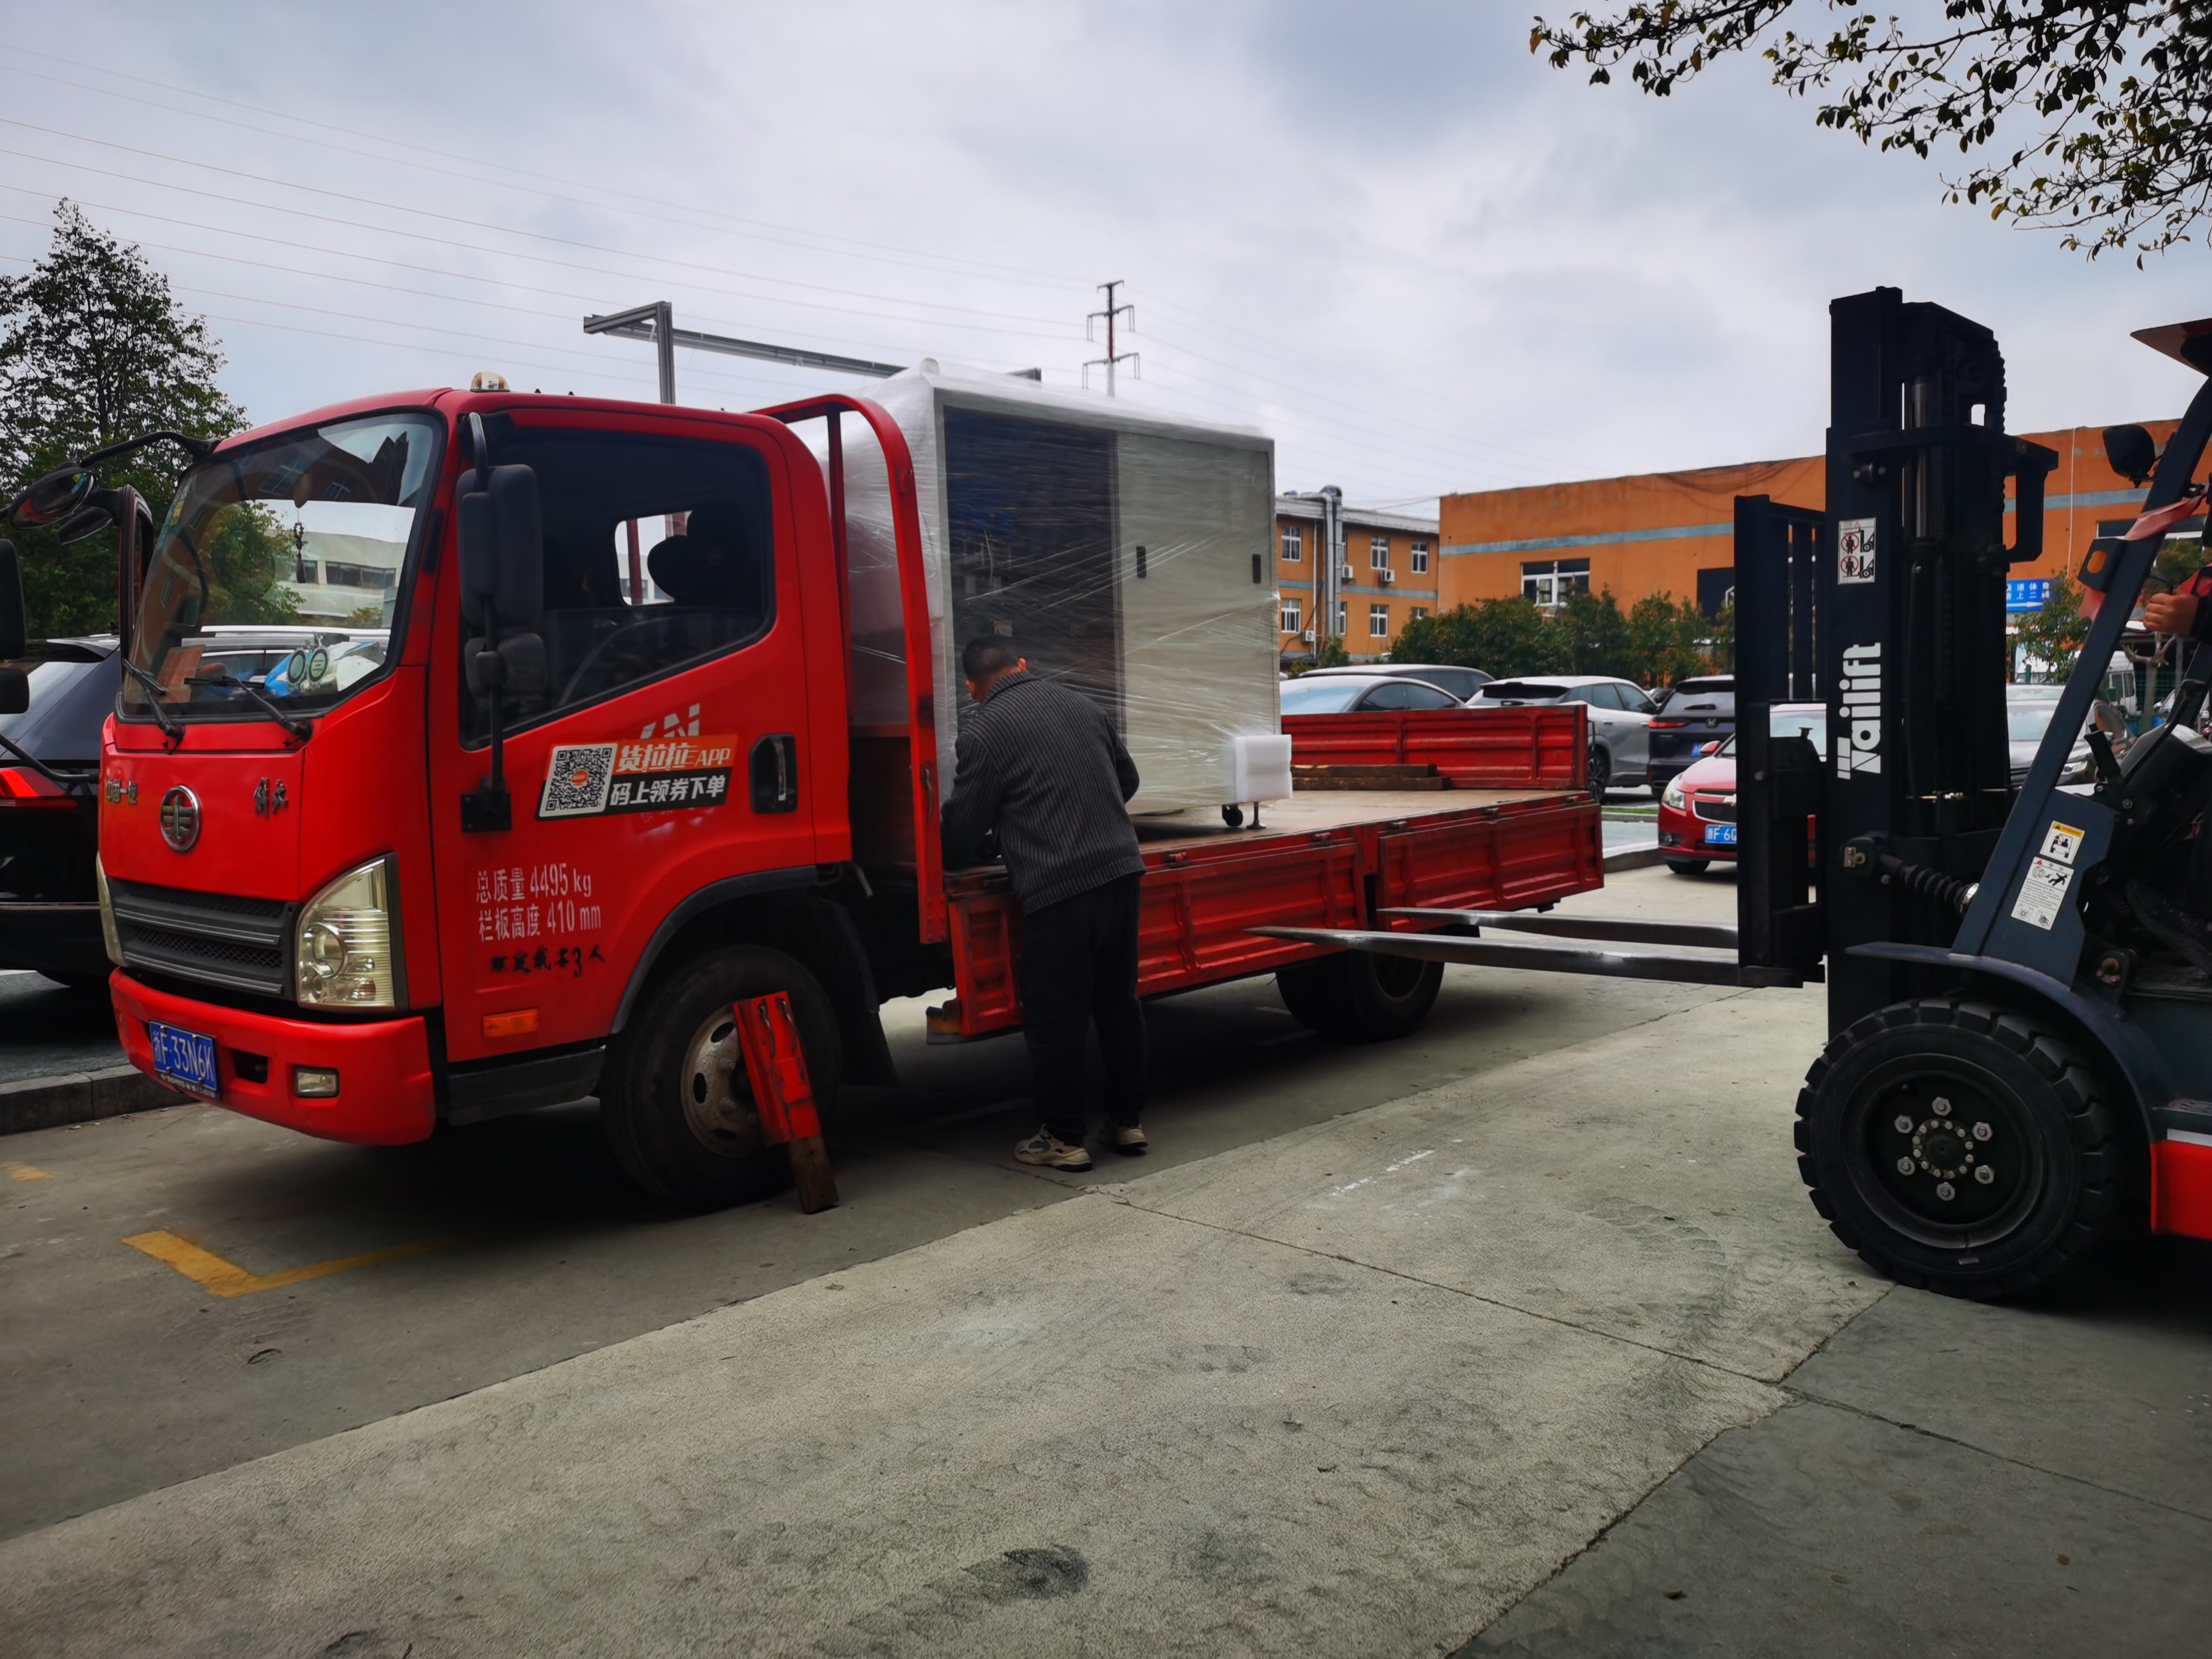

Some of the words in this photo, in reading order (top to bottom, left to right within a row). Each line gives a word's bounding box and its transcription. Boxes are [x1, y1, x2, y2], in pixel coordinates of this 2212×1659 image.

[1837, 642, 1881, 780] Tailift
[609, 775, 726, 806] 码上领券下单
[476, 867, 526, 903] 总质量
[530, 862, 569, 899] 4495
[573, 868, 592, 897] kg
[478, 903, 541, 942] 栏板高度
[547, 900, 575, 934] 410
[580, 904, 602, 930] mm
